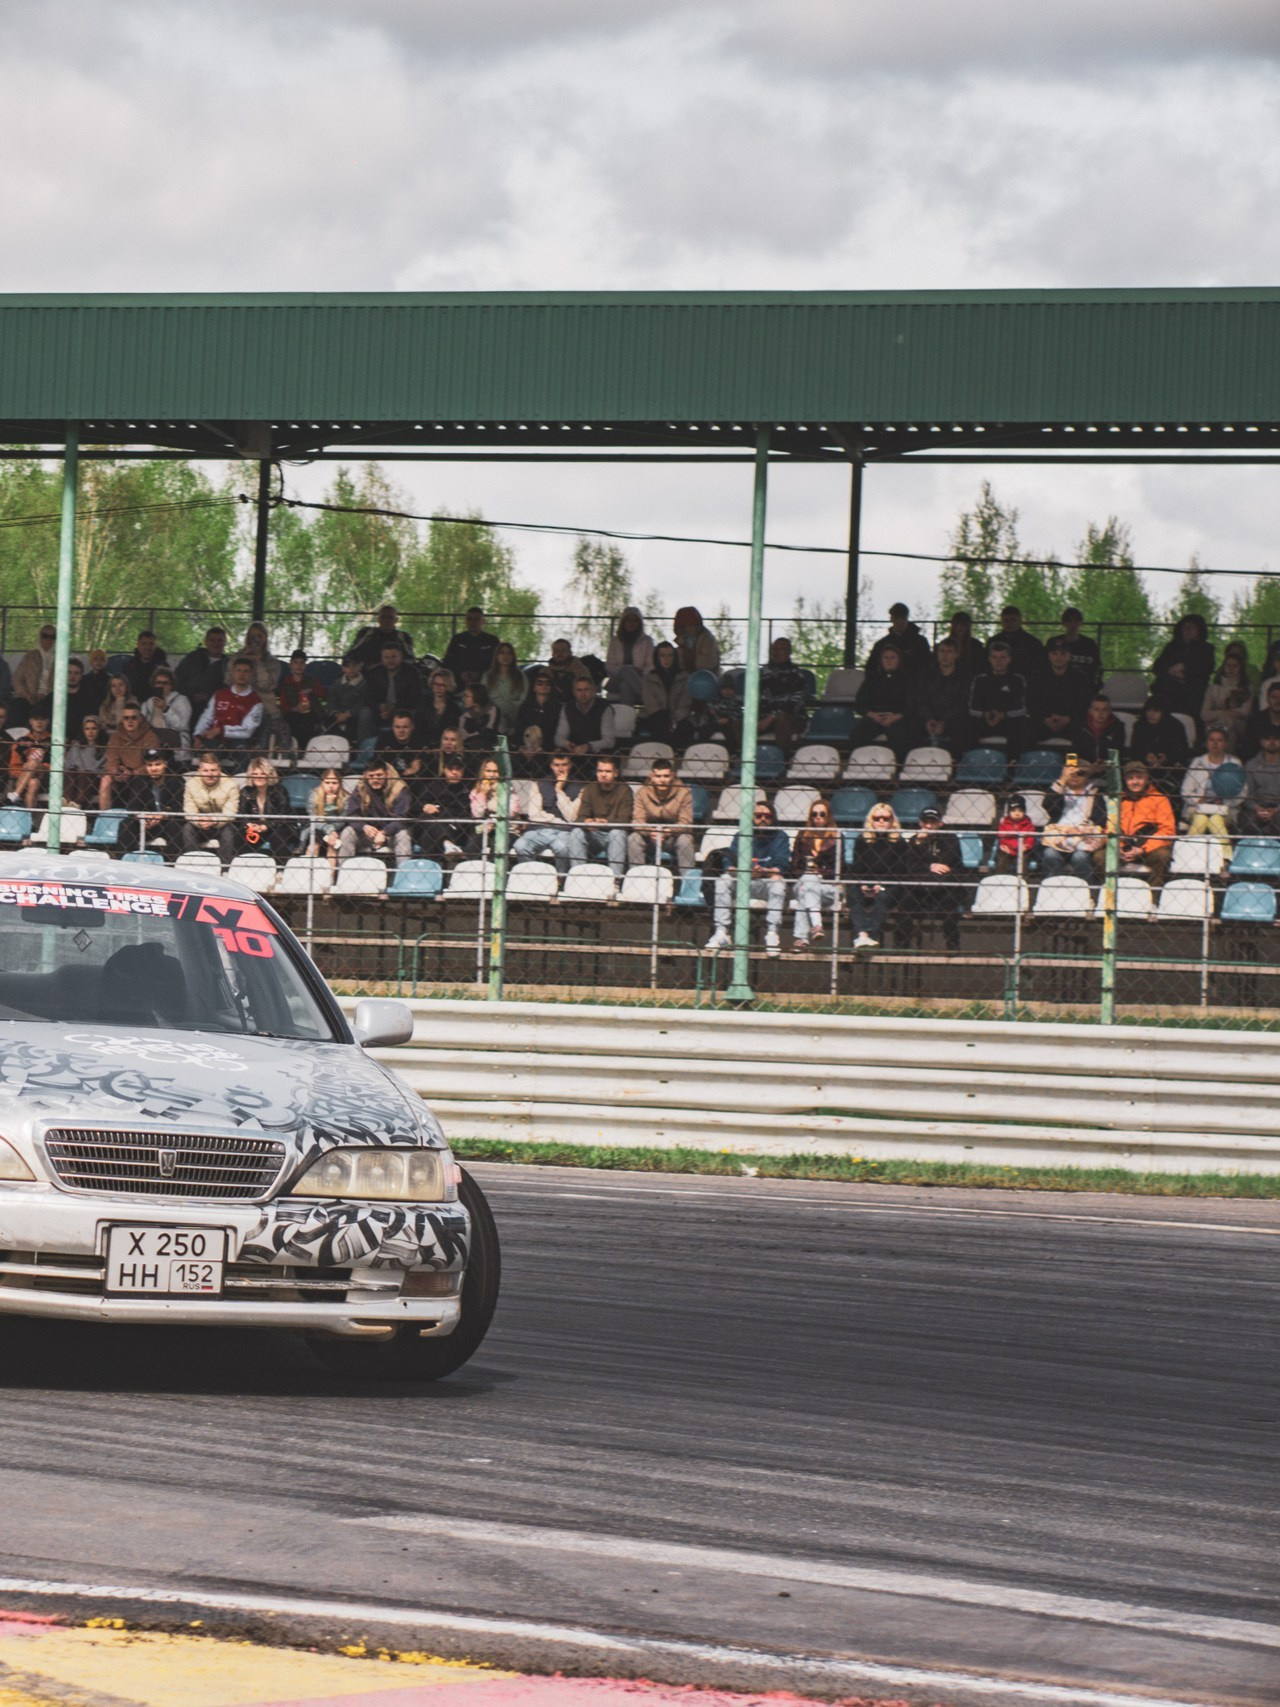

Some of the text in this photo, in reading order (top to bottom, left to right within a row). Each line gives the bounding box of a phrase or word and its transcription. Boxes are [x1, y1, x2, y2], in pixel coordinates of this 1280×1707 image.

[102, 890, 165, 904] TIRES
[156, 1233, 206, 1257] 250
[119, 1263, 213, 1287] HH 152
[183, 1282, 200, 1290] RUS
